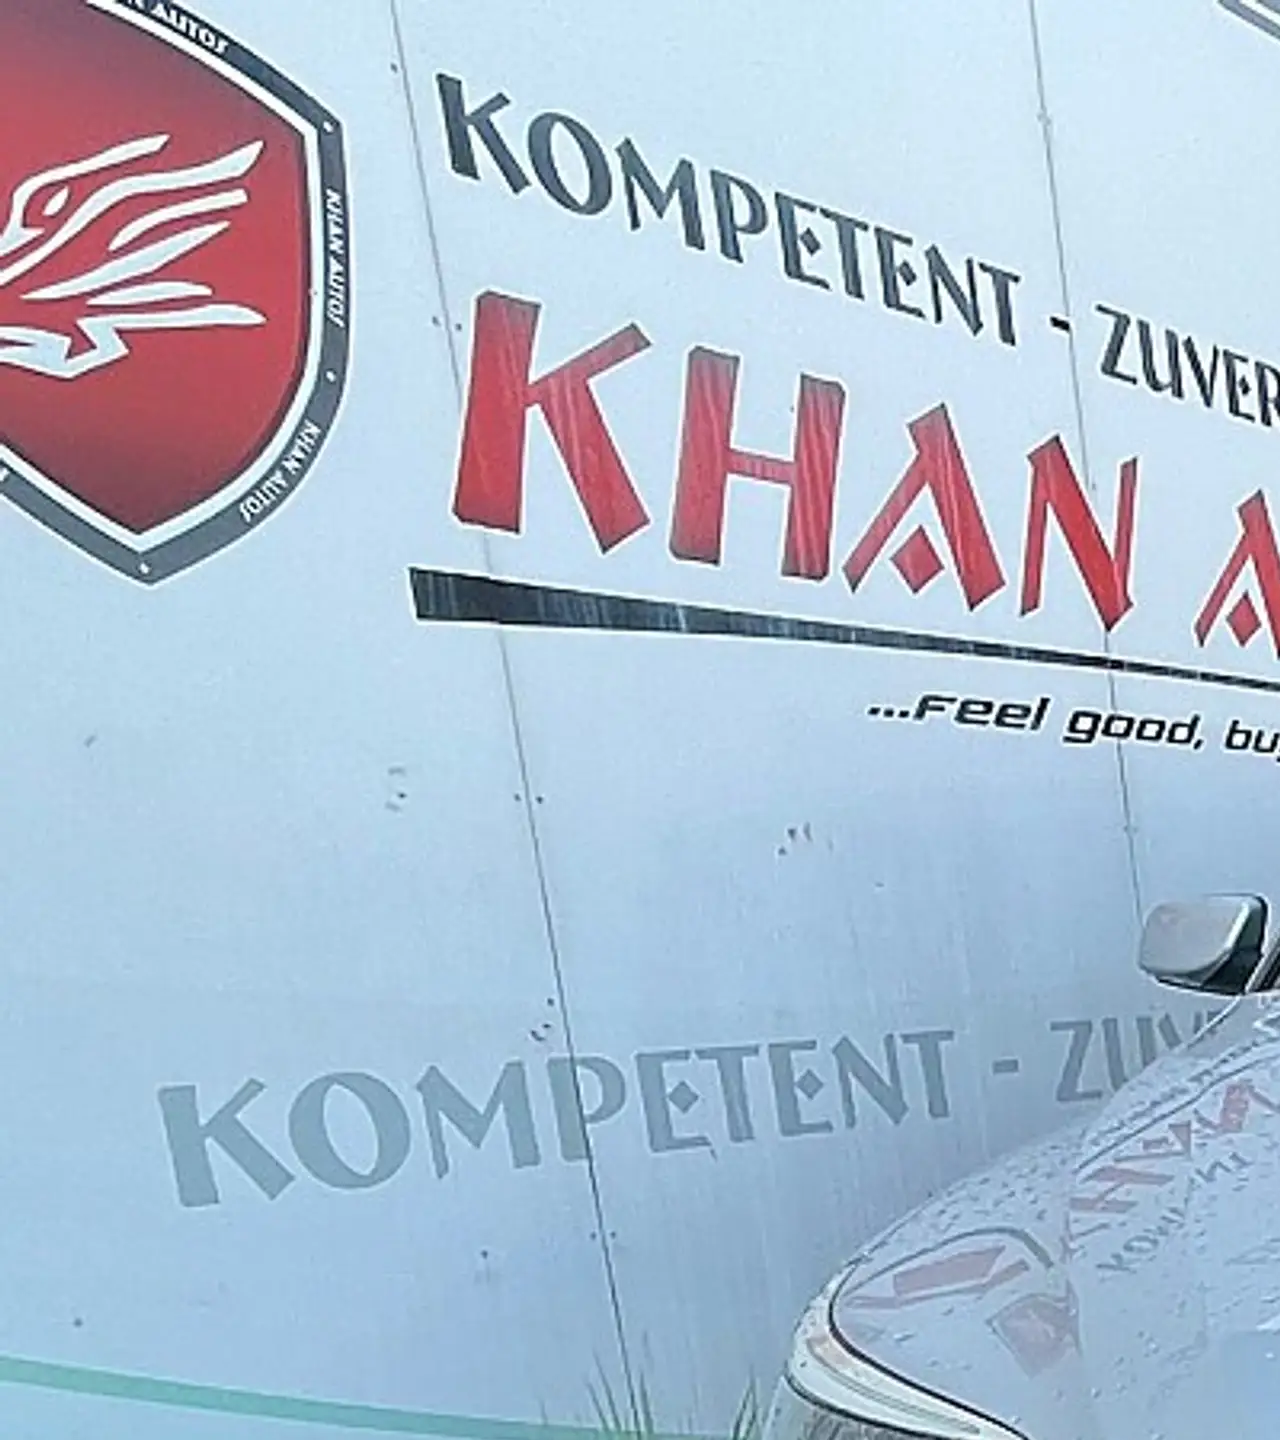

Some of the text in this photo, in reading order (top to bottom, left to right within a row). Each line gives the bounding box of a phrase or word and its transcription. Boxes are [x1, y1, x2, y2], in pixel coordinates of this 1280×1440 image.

[153, 3, 228, 53] AUTOS
[326, 188, 347, 328] KHAN AUTOS
[436, 73, 1020, 346] KOMPETENT
[1050, 316, 1070, 331] -
[239, 419, 322, 523] KHAN AUTOS
[452, 291, 1137, 633] KHAN
[1063, 708, 1203, 750] good,
[157, 1029, 955, 1207] KOMPETENT
[992, 1058, 1019, 1074] -
